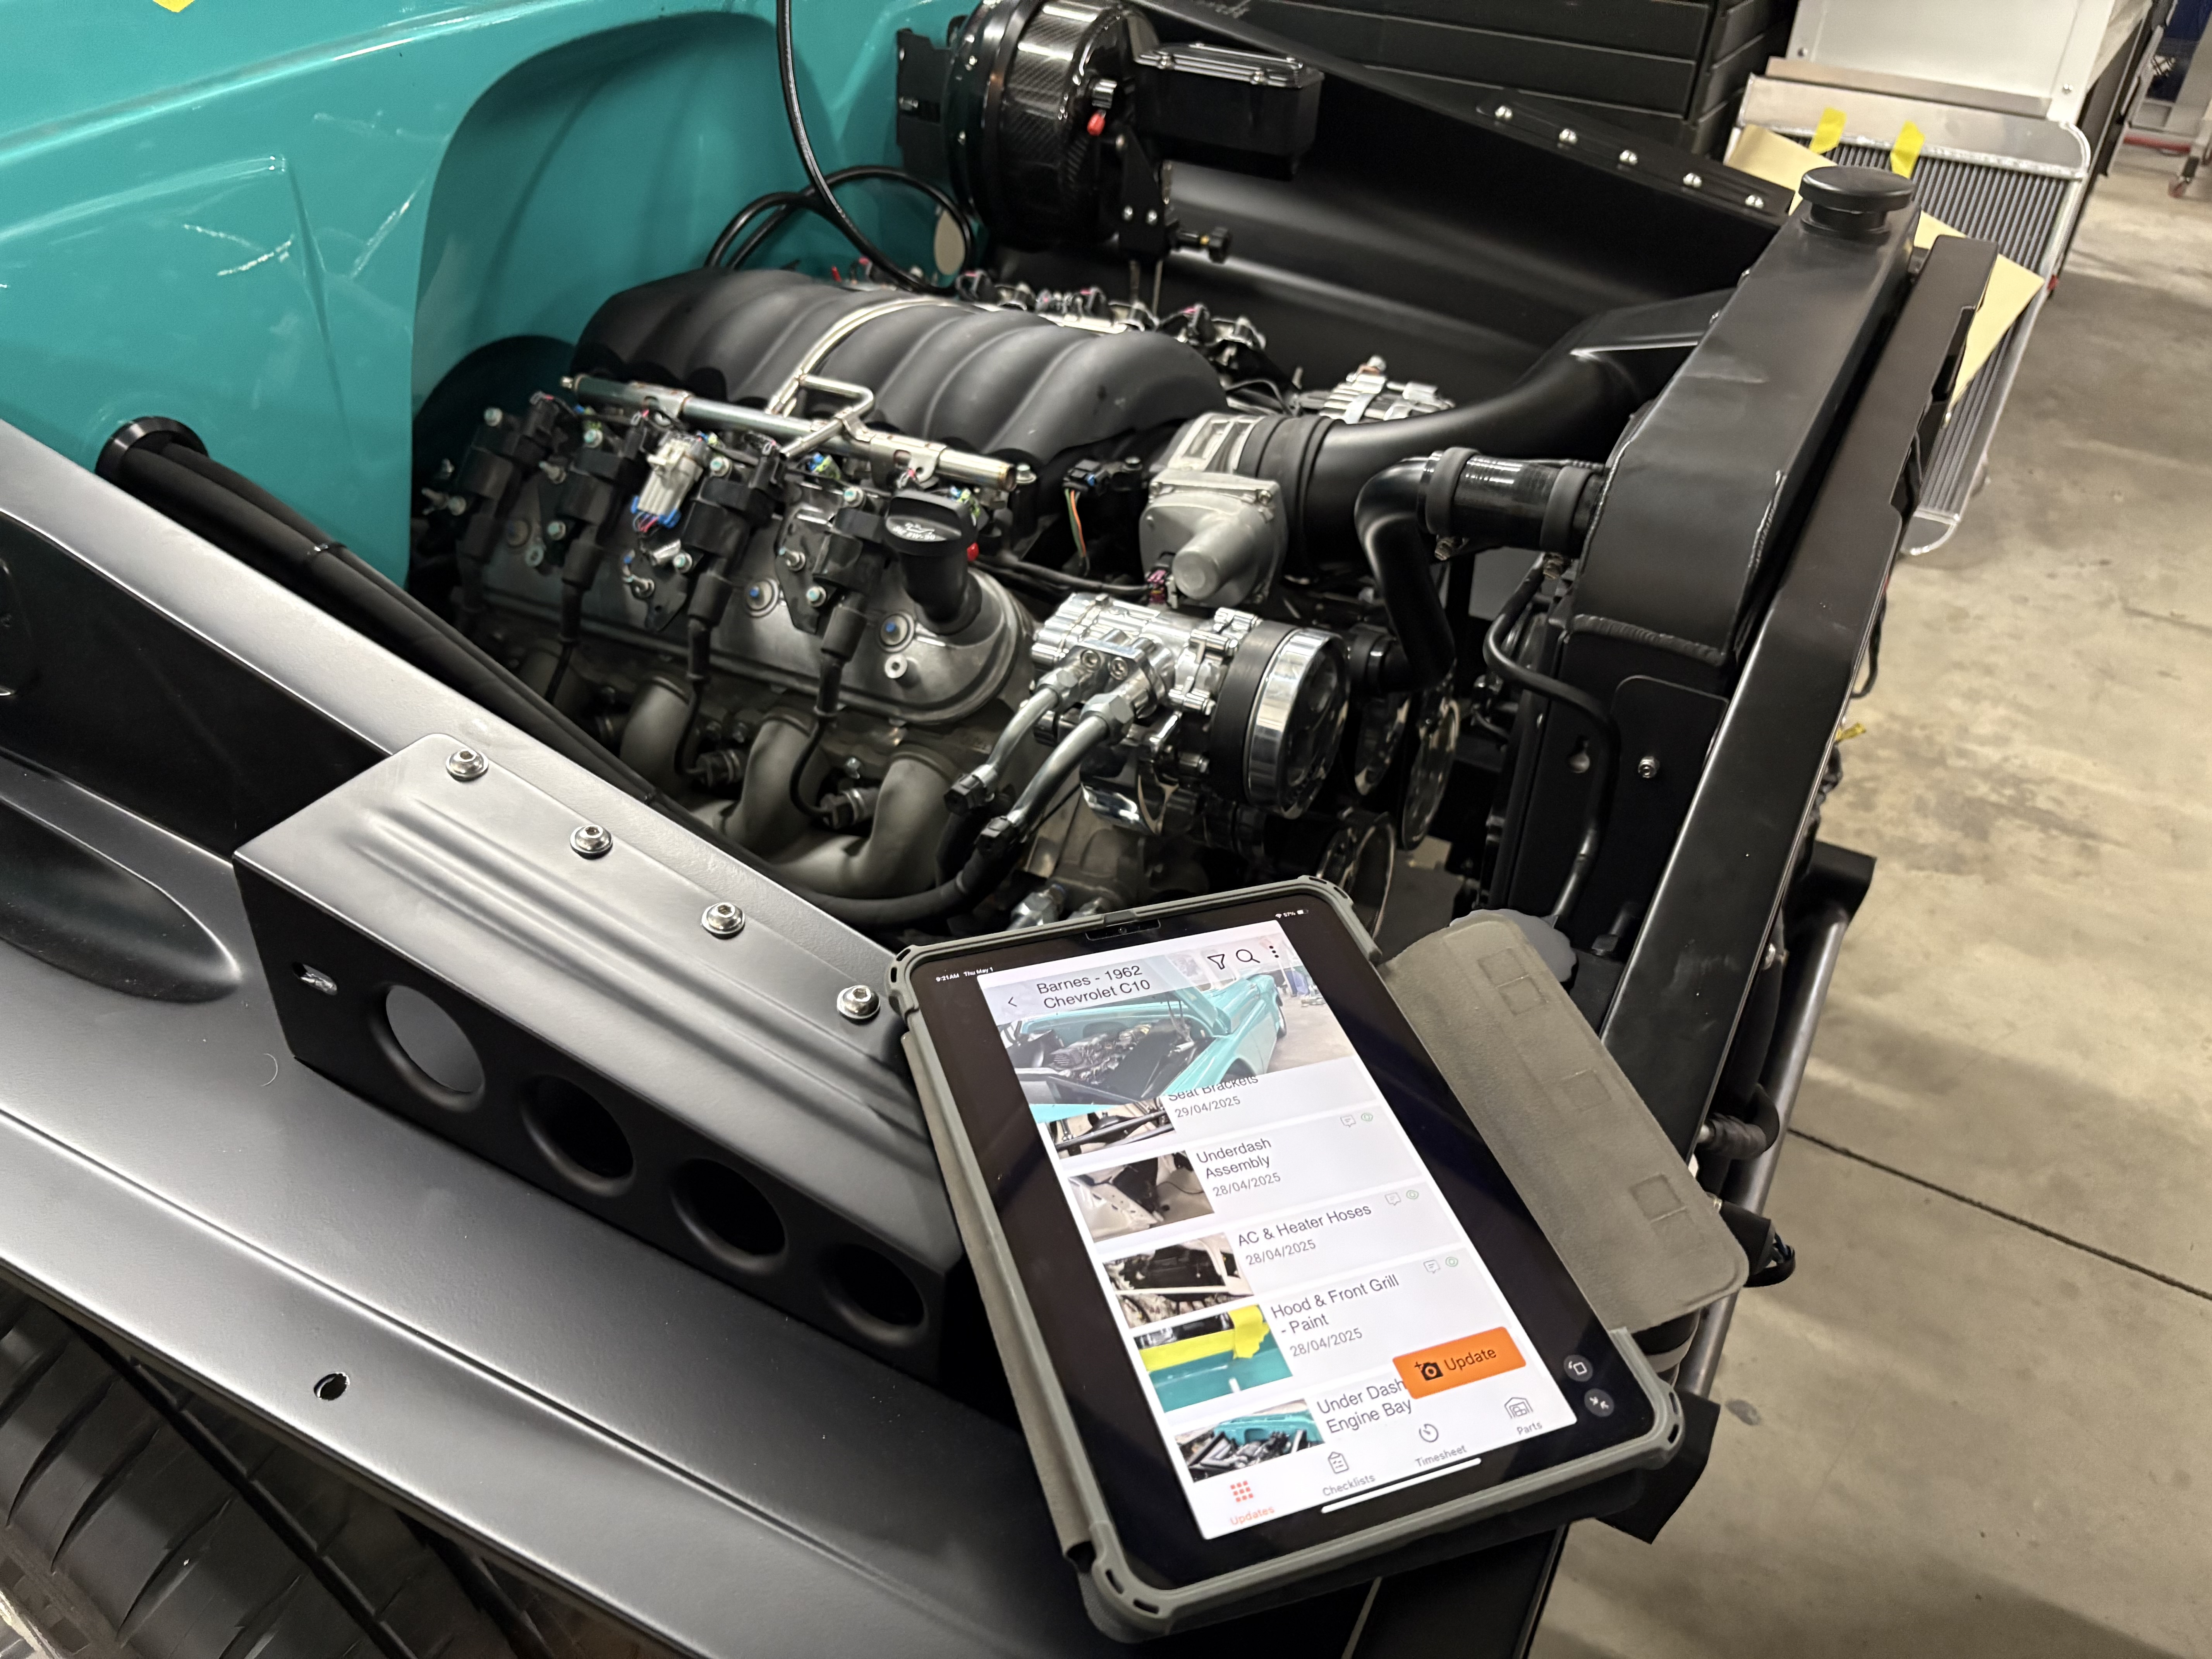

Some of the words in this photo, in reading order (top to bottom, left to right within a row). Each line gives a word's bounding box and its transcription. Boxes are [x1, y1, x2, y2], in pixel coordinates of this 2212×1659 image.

[1037, 977, 1091, 994] Barnes
[1104, 965, 1142, 981] 1962
[1044, 986, 1117, 1008] Chevrolet
[1120, 979, 1150, 994] C10
[1202, 1075, 1259, 1094] Brackets
[1175, 1096, 1240, 1118] 29/04/2025
[1196, 1138, 1272, 1163] Underdash
[1207, 1155, 1270, 1179] Assembly
[1212, 1172, 1281, 1197] 28/04/2025
[1239, 1231, 1259, 1247] AC
[1263, 1228, 1275, 1240] &
[1276, 1217, 1324, 1237] Heater
[1326, 1206, 1372, 1224] Hoses
[1245, 1239, 1316, 1266] 28/04/2025
[1271, 1297, 1312, 1319] Hood
[1314, 1294, 1327, 1307] &
[1328, 1283, 1368, 1303] Front
[1369, 1274, 1400, 1292] Grill
[1289, 1313, 1329, 1334] Paint
[1289, 1328, 1363, 1357] 28/04/2025
[1444, 1348, 1497, 1372] Update
[1317, 1391, 1363, 1415] Under
[1366, 1378, 1408, 1400] Dash
[1326, 1408, 1380, 1434] Engine
[1382, 1399, 1412, 1417] Bay
[1516, 1421, 1543, 1436] Parts
[1415, 1445, 1468, 1467] Timesheet
[1322, 1474, 1376, 1496] Checklists
[1230, 1506, 1275, 1525] Updates
